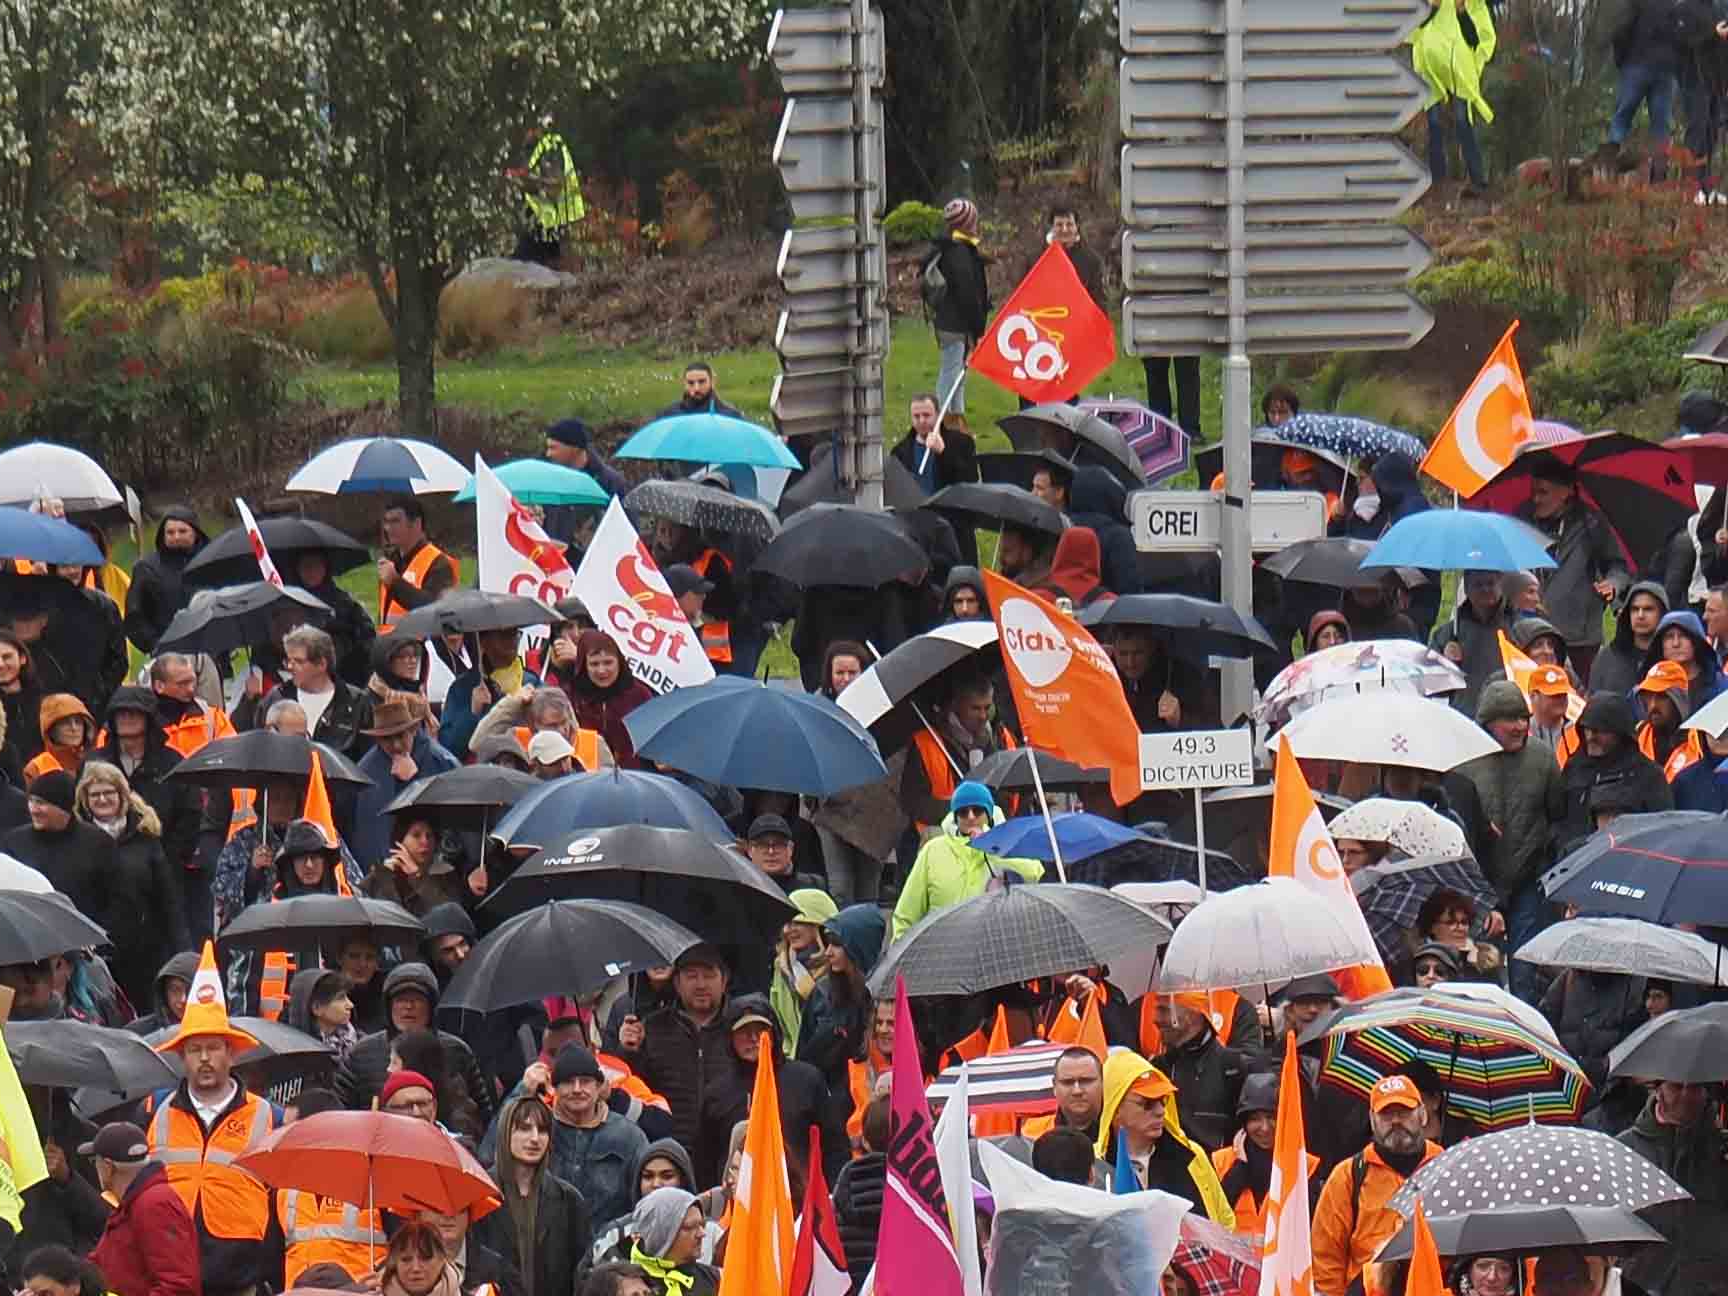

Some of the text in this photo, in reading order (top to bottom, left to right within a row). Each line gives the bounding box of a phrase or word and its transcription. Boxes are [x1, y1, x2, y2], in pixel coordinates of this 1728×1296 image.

[1148, 510, 1199, 537] CREI
[608, 603, 688, 664] cgt
[1171, 736, 1217, 756] 49.3
[1142, 763, 1252, 784] DICTATURE
